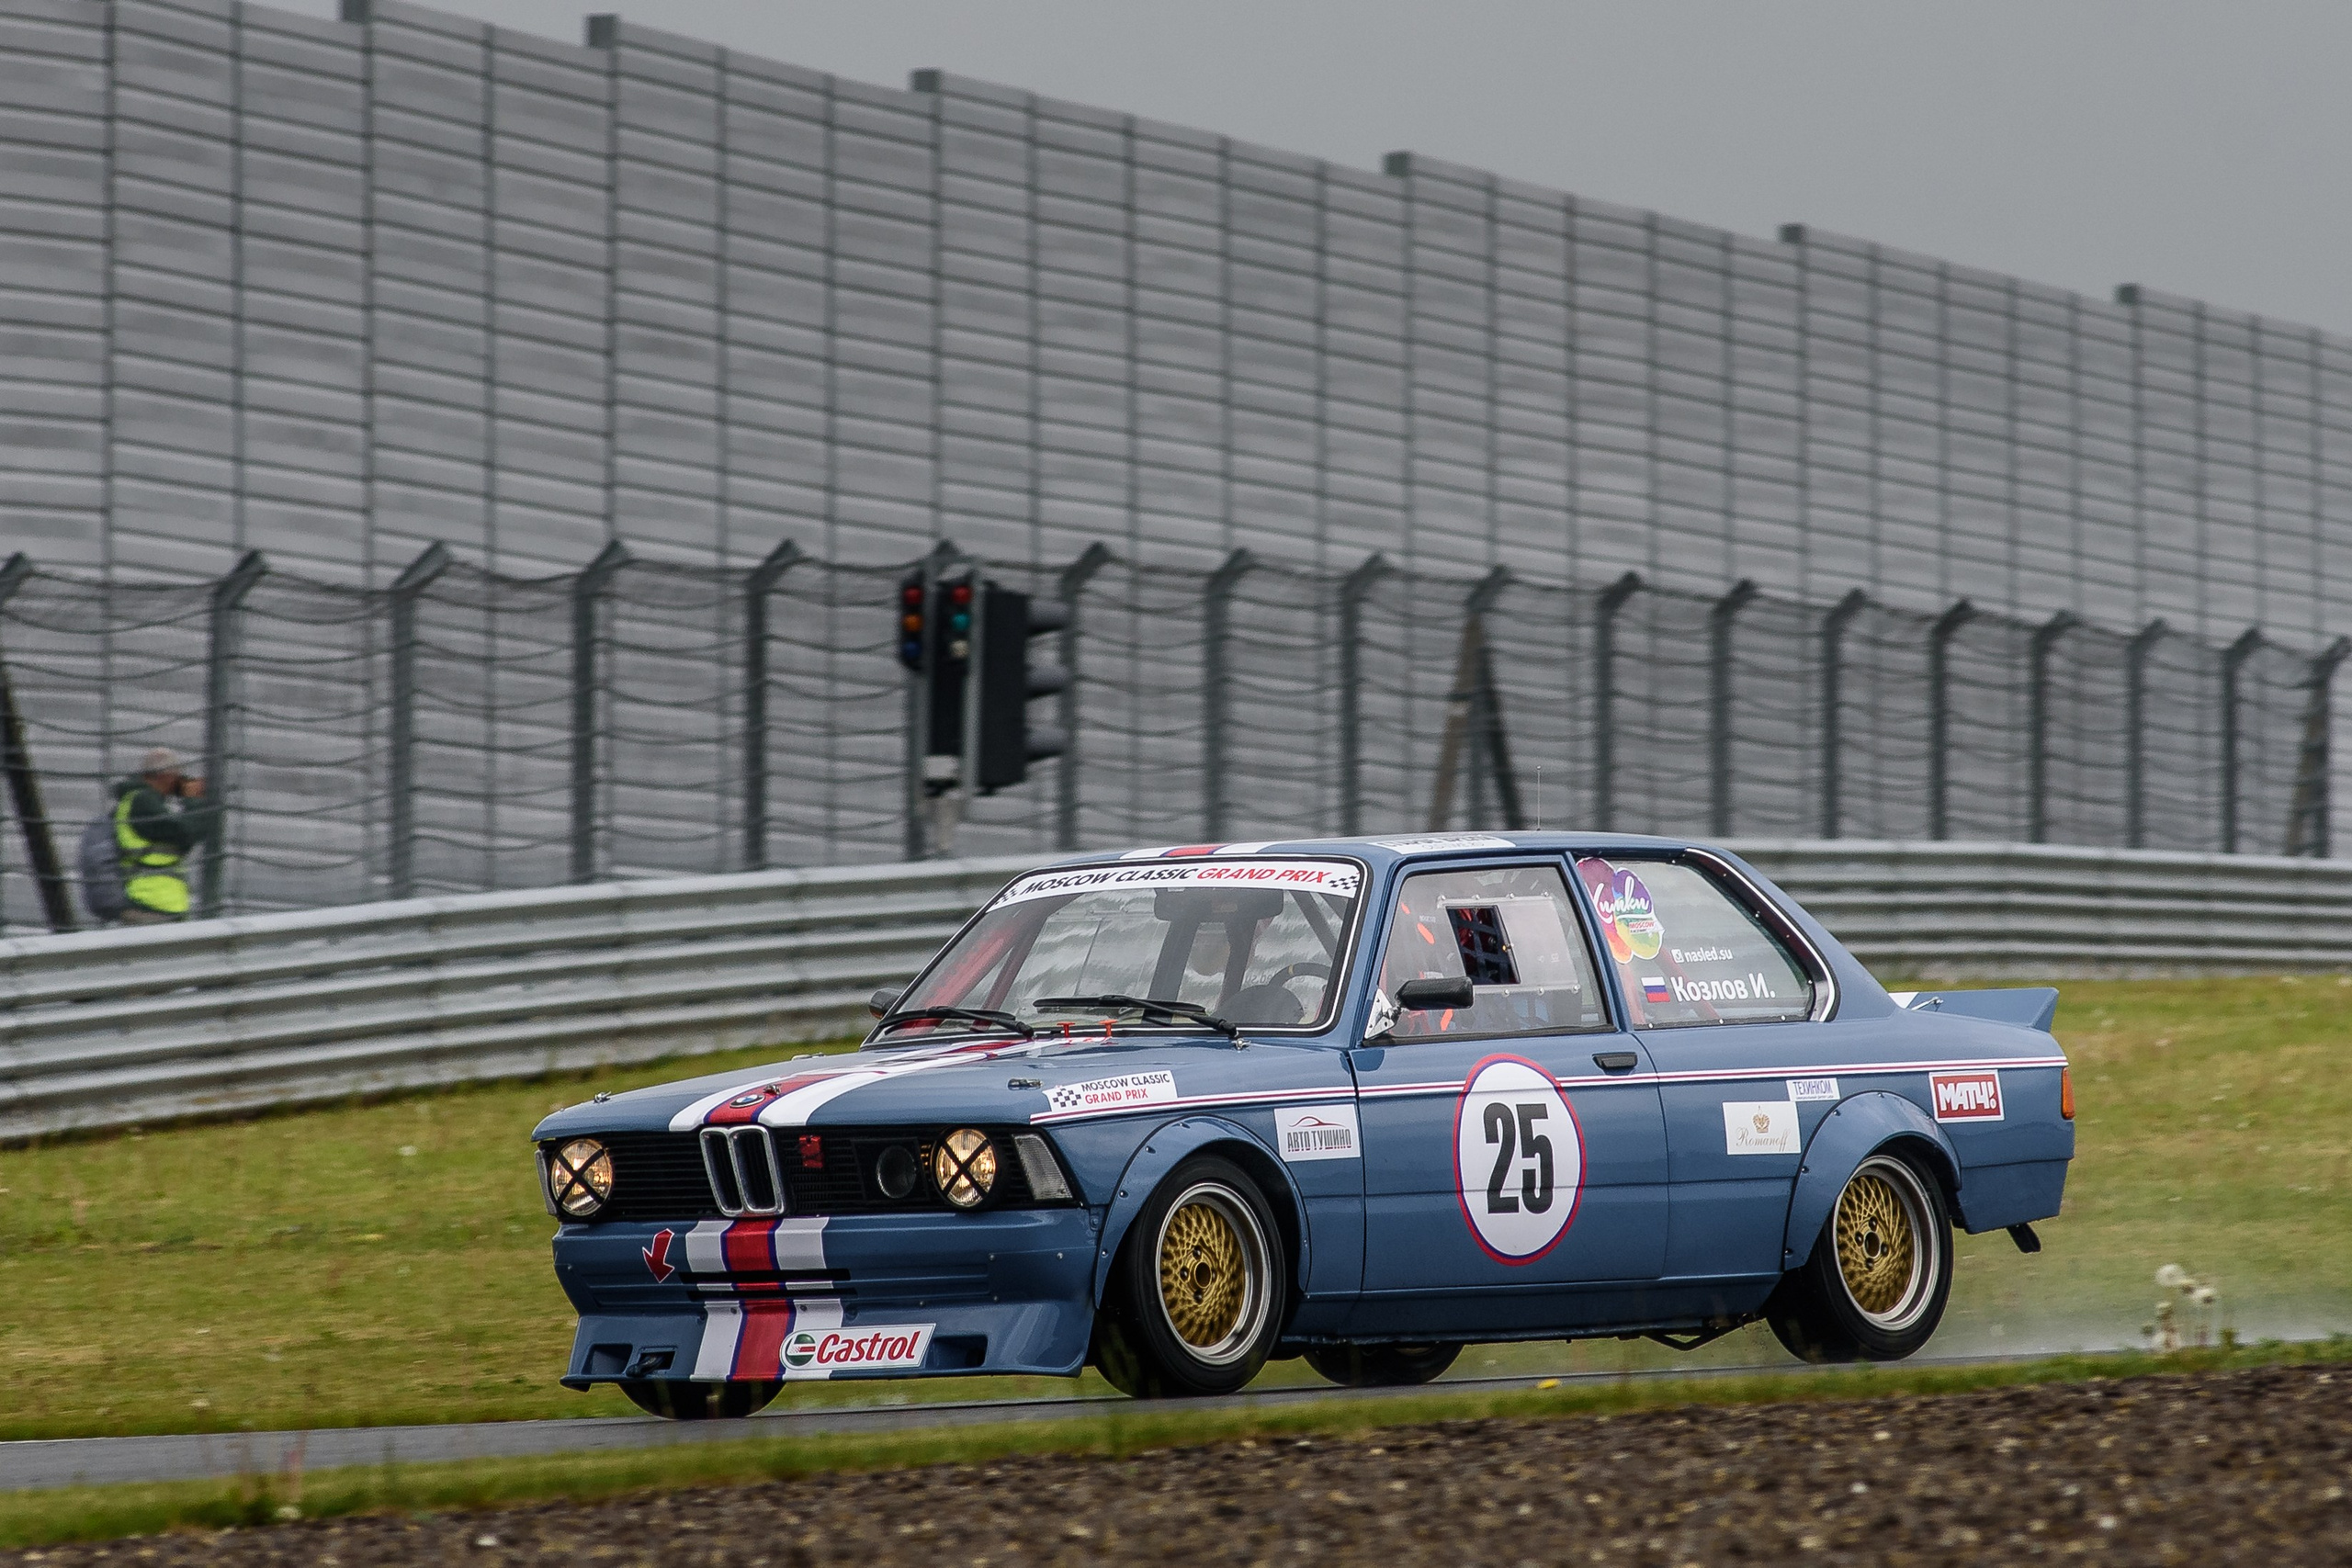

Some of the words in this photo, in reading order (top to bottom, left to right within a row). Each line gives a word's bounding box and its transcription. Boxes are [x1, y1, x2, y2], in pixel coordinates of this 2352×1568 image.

[1019, 872, 1117, 896] MOSCOW
[1114, 868, 1198, 884] CLASSIC
[1197, 868, 1277, 881] GRAND
[1274, 869, 1331, 884] PRIX
[1684, 946, 1733, 963] nasled.su
[1670, 976, 1748, 1002] Козлов
[1748, 972, 1776, 999] И.
[1080, 1077, 1129, 1092] MOSCOW
[1131, 1074, 1170, 1086] CLASSIC
[1792, 1079, 1834, 1096] ТЕХИНКОМ
[1084, 1091, 1122, 1104] GRAND
[1125, 1089, 1148, 1100] PRIX
[1937, 1081, 1998, 1111] МАТЧ!
[1287, 1131, 1311, 1152] АВТО
[1311, 1129, 1351, 1150] ТУШИНО
[1736, 1127, 1791, 1152] Romanoff
[1483, 1102, 1555, 1214] 25
[817, 1331, 921, 1363] Castrol
